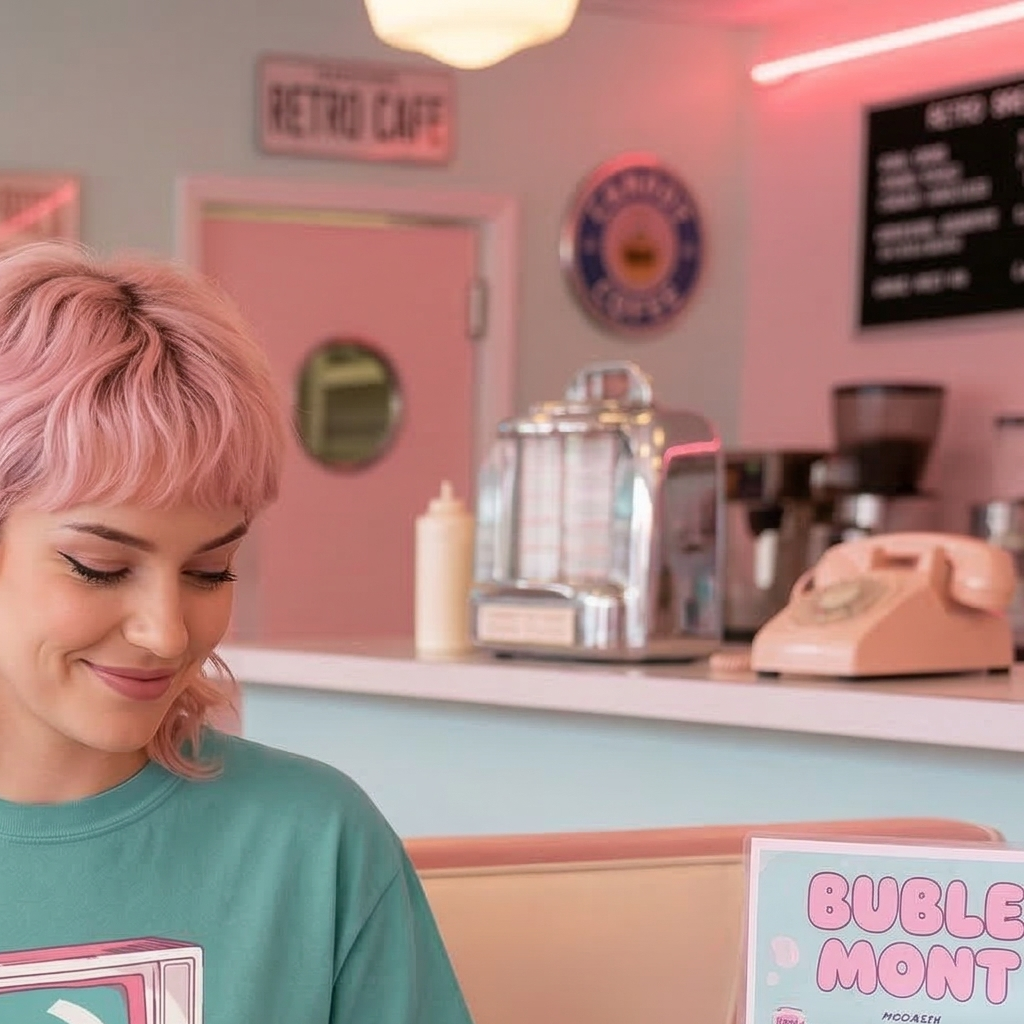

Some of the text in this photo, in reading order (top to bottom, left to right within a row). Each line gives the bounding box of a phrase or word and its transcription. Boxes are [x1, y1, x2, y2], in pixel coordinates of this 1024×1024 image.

[269, 82, 362, 141] RETRO
[807, 871, 1024, 941] BUBLE
[816, 937, 1022, 1005] MONT
